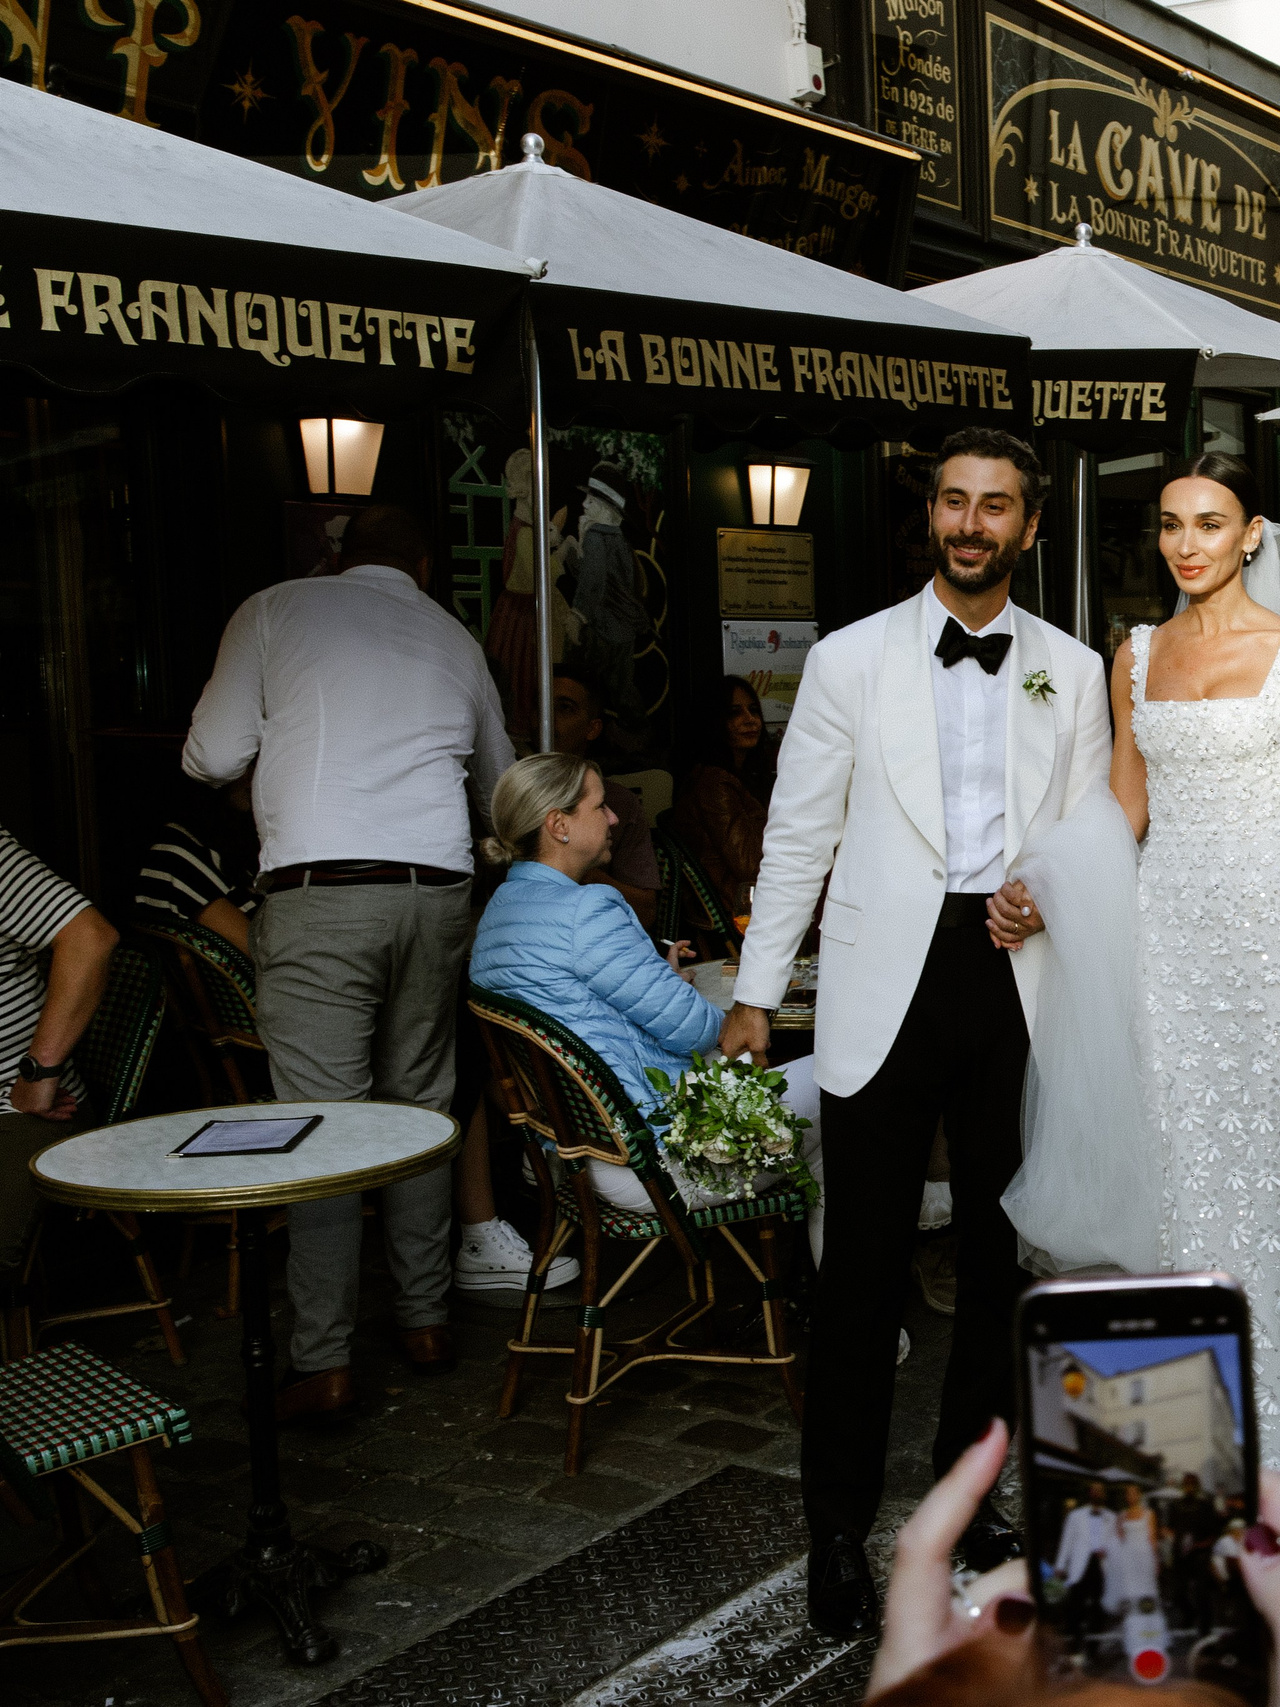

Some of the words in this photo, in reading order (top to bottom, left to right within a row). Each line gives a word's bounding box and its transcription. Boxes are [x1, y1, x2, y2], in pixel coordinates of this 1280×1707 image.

[880, 75, 899, 103] En
[903, 87, 934, 117] 1925
[936, 97, 955, 122] de
[881, 25, 951, 84] Fondée
[285, 15, 595, 191] VINS
[799, 147, 881, 220] Manger,
[1049, 109, 1088, 175] LA
[1095, 120, 1221, 235] CAVE
[1234, 184, 1267, 241] DE
[1050, 181, 1081, 224] LA
[1087, 195, 1151, 247] BONNE
[1154, 218, 1267, 286] FRANQUETTE
[33, 267, 477, 375] FRANQUETTE
[566, 328, 631, 382] LA
[639, 333, 782, 391] BONNE
[789, 346, 1014, 411] FRANQUETTE
